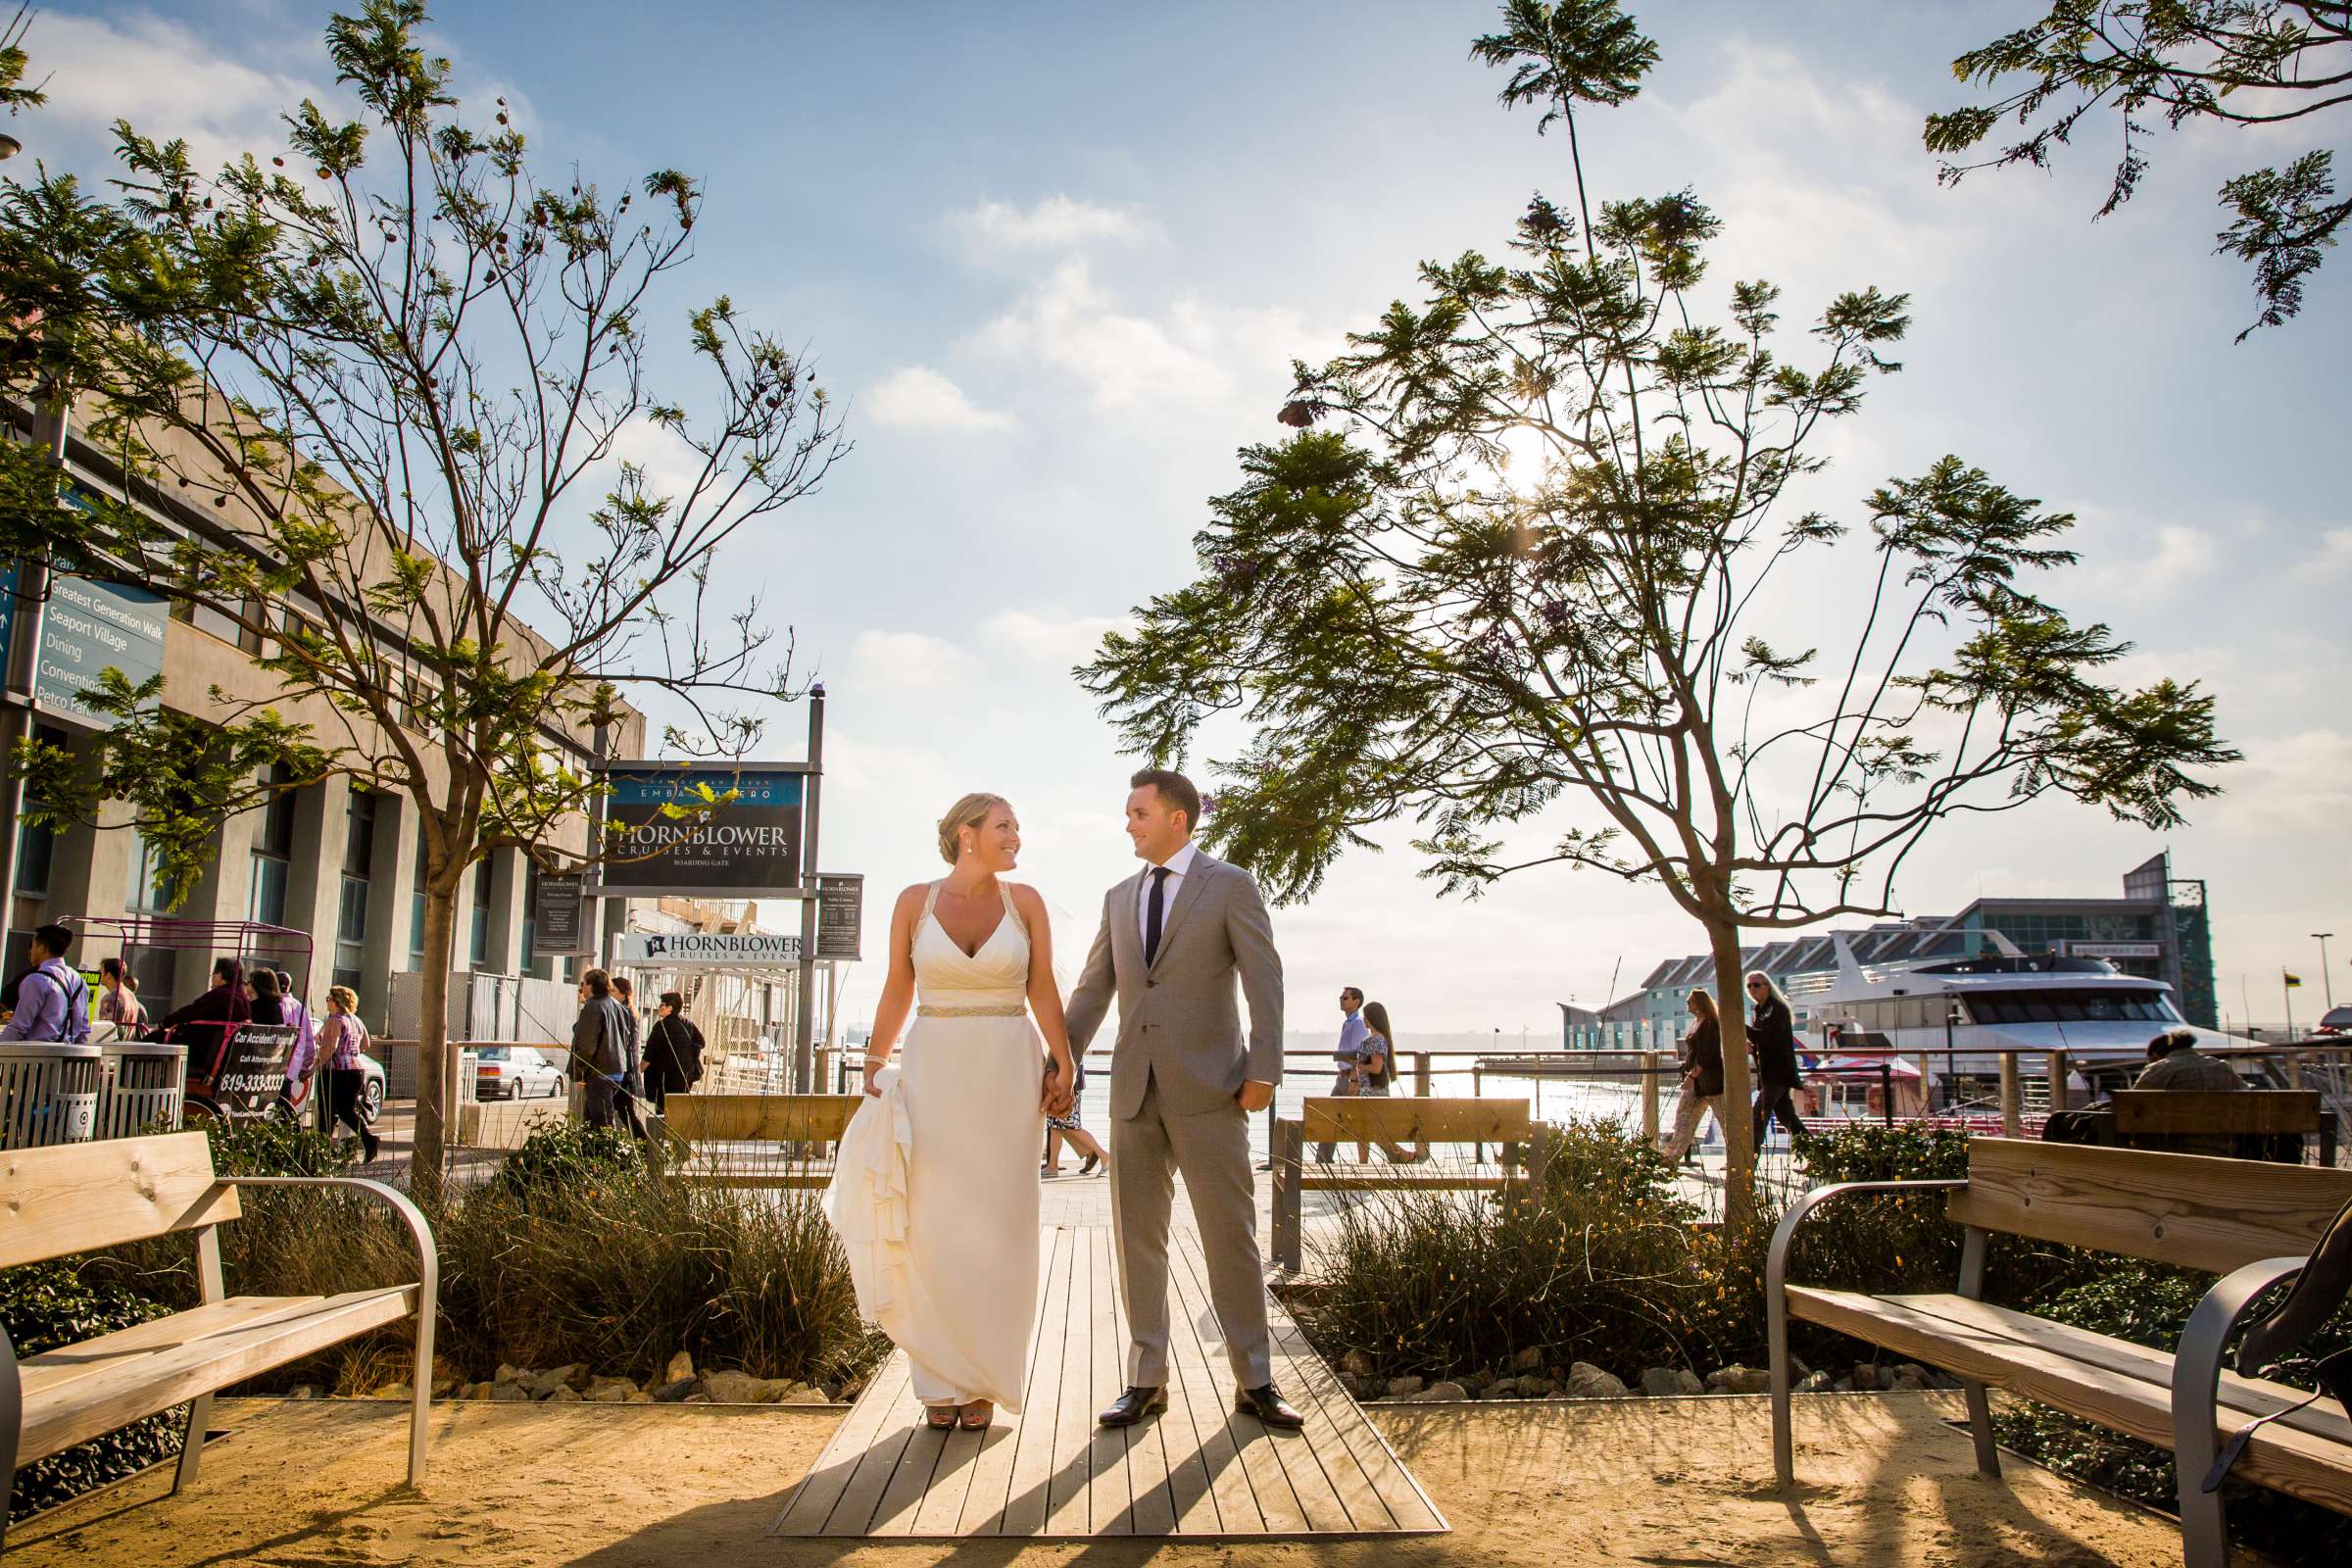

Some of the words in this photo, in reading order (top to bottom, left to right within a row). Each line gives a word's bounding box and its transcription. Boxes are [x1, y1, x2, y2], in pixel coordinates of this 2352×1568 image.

[51, 579, 91, 609] Greatest
[93, 599, 141, 630] Generation
[143, 620, 163, 641] Walk
[49, 606, 92, 636] Seaport
[94, 625, 127, 652] Village
[46, 632, 82, 663] Dining
[37, 685, 68, 710] Petco
[641, 789, 770, 800] EMBAAERO
[617, 846, 691, 856] CRUISES
[703, 846, 712, 856] &
[723, 846, 788, 857] EVENTS
[670, 936, 802, 953] HORNBLOWER
[234, 1031, 247, 1043] Car
[246, 1032, 276, 1045] Accident?
[239, 1054, 252, 1063] Call
[220, 1073, 285, 1093] 619-333-3333
